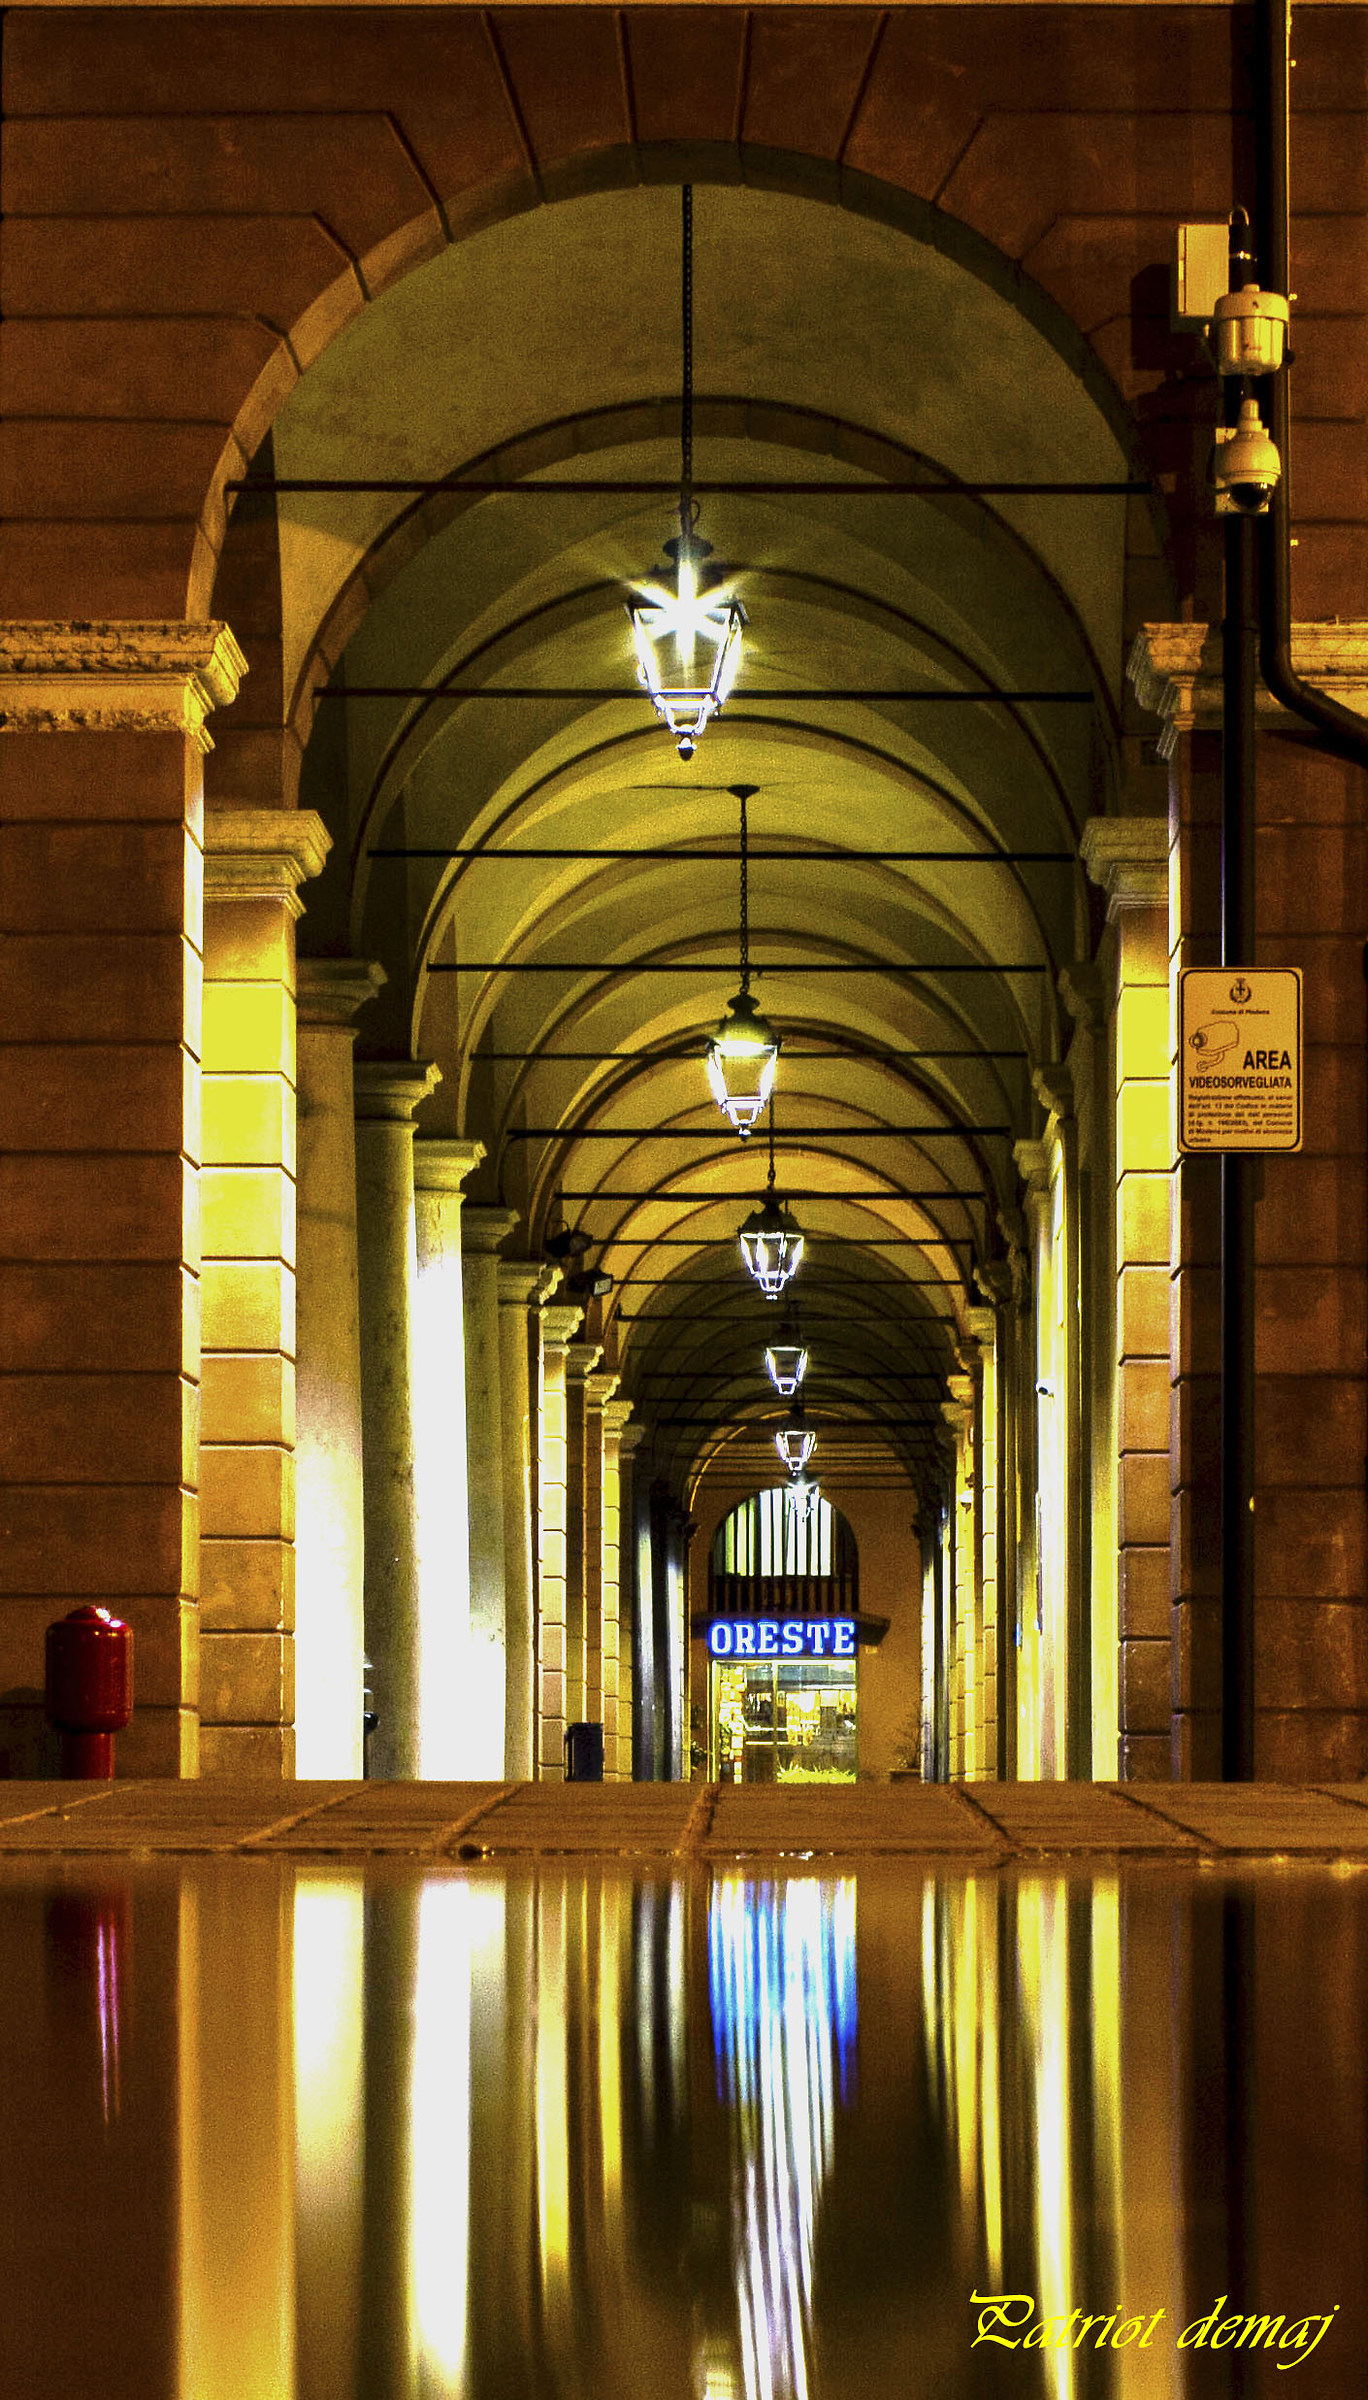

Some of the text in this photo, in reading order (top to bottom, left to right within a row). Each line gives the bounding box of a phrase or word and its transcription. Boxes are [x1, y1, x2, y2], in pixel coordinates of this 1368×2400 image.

[1242, 1050, 1292, 1070] AREA
[1188, 1076, 1292, 1088] VIDEOSORVEGLIATA
[710, 1620, 856, 1655] ORESTE
